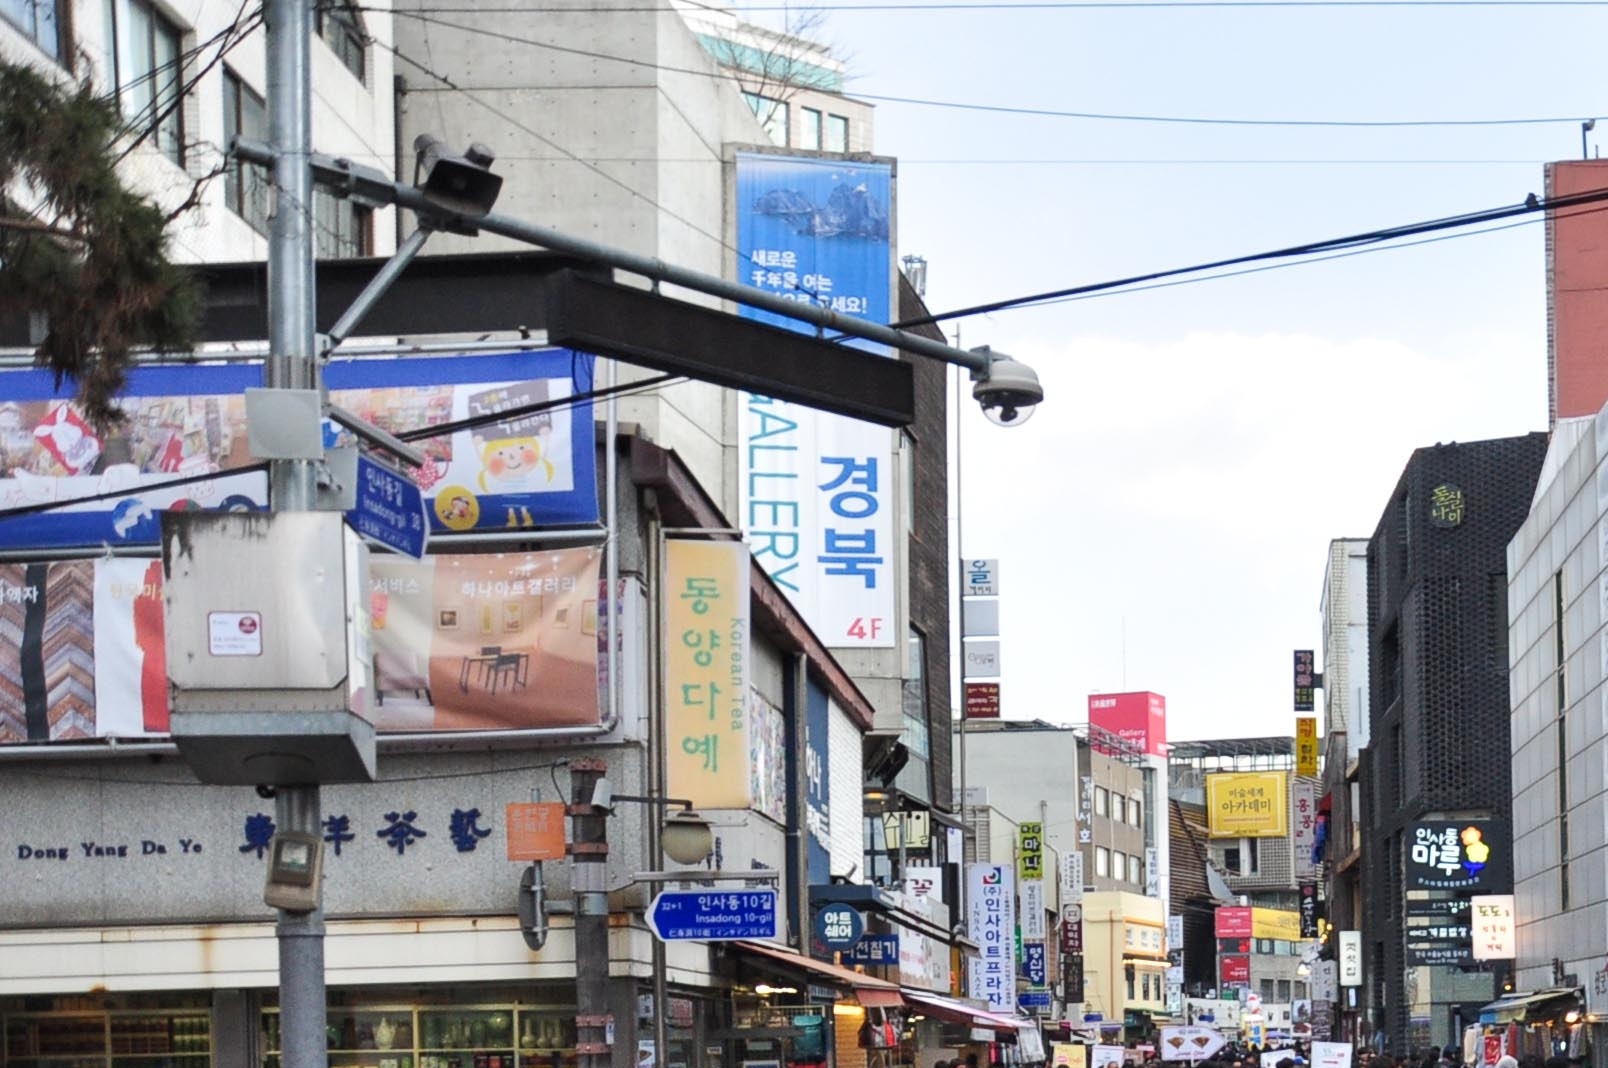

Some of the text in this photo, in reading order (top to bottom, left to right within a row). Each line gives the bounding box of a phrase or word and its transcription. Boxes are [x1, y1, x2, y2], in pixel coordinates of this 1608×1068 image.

[751, 249, 797, 268] 새로운
[803, 274, 833, 291] 여는
[817, 455, 884, 589] 경북
[846, 617, 884, 640] 4F
[681, 577, 721, 773] 동양다예
[731, 617, 746, 731] Korean Tea
[1221, 798, 1272, 814] 아카데미
[1415, 827, 1459, 847] 인사동
[18, 845, 69, 860] Dong
[81, 841, 129, 858] Yang
[141, 840, 167, 855] Da
[1411, 843, 1461, 877] 마루
[697, 894, 772, 911] 인사동10길
[695, 912, 772, 924] Insadong 10-gil
[824, 911, 852, 925] 아트
